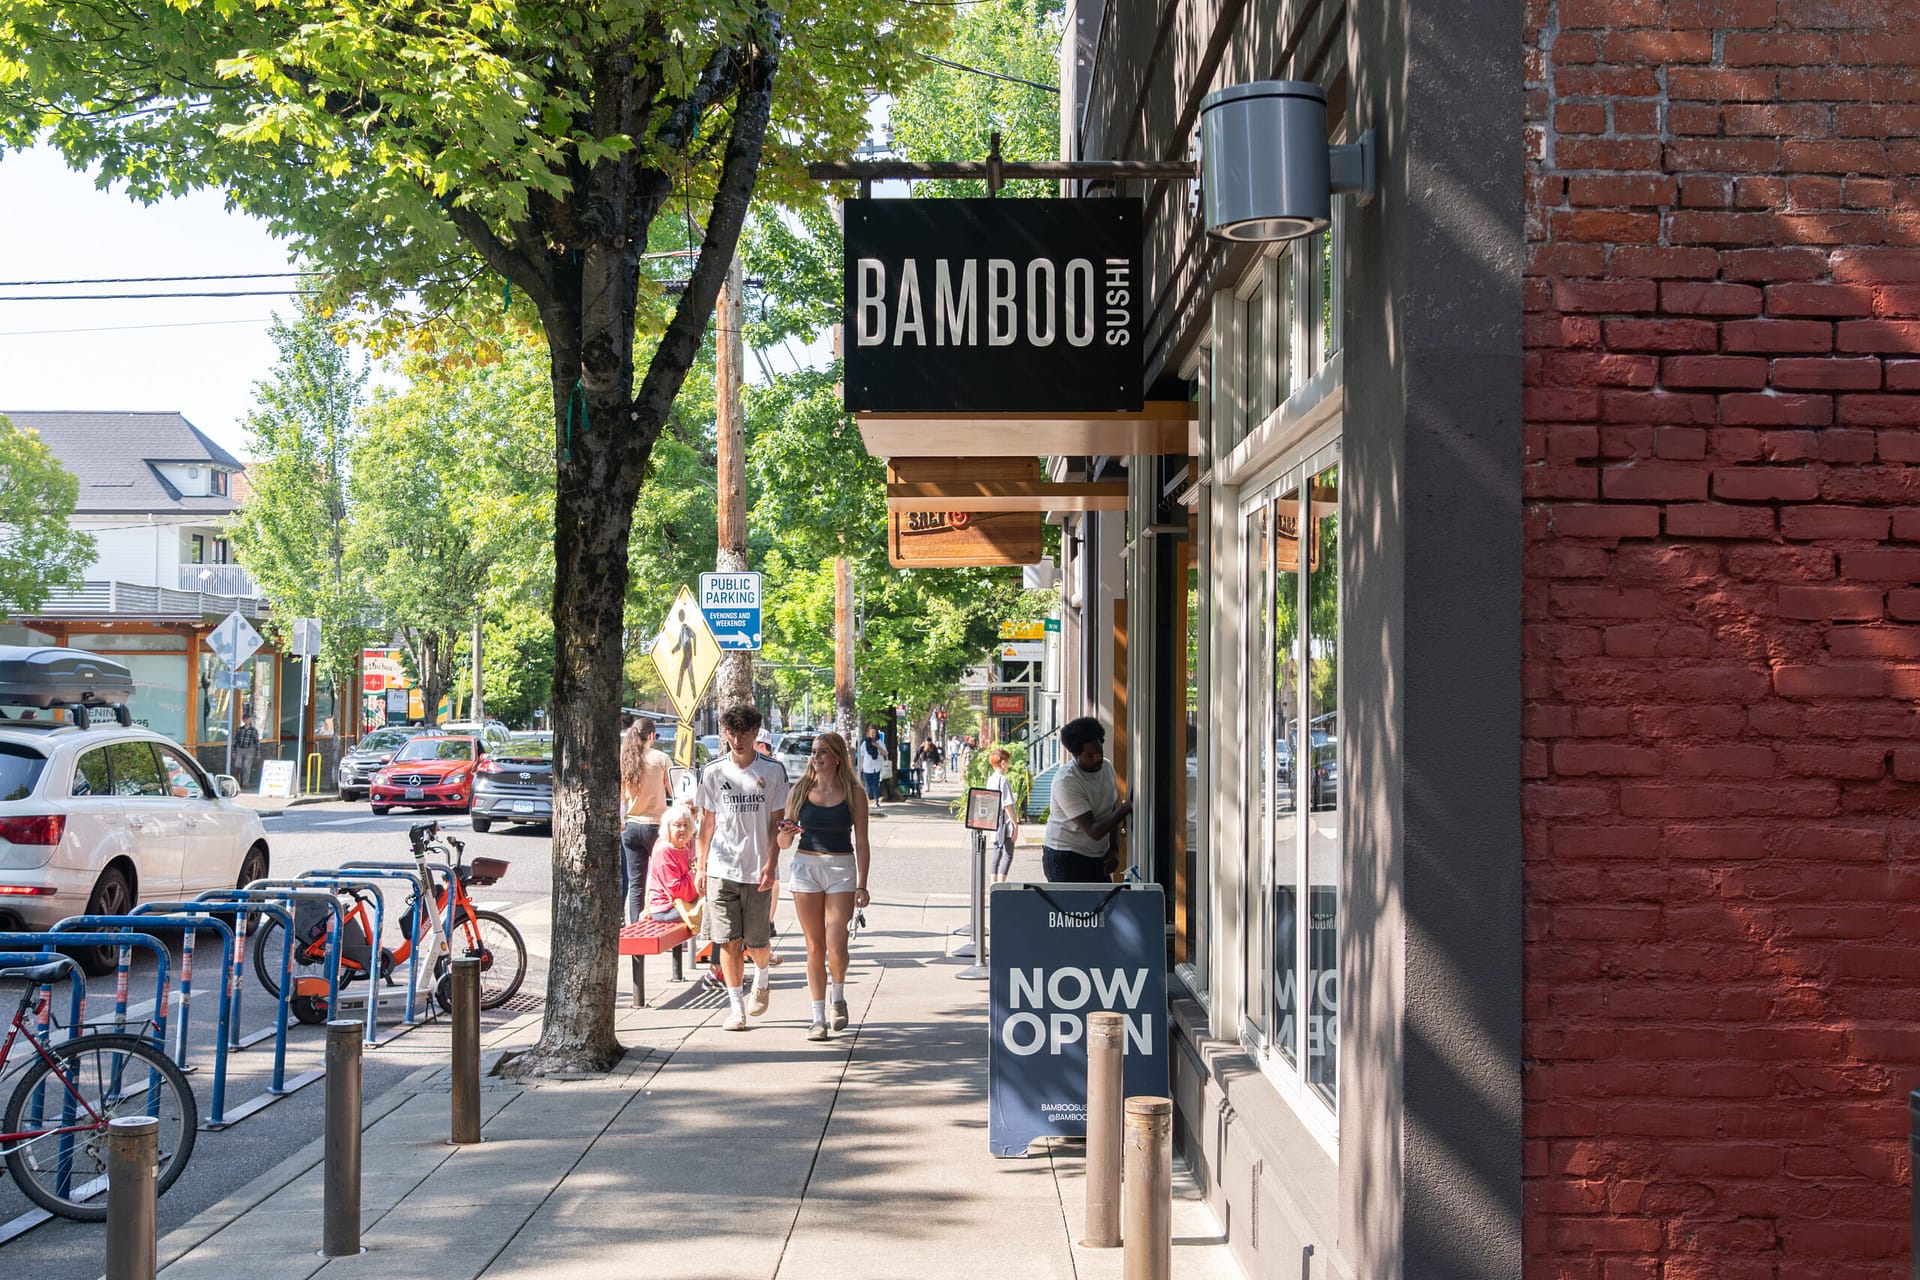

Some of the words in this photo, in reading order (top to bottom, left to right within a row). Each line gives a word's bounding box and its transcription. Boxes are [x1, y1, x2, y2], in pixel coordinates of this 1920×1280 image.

[857, 257, 1095, 348] BAMBOO
[1105, 257, 1131, 347] SUSHI
[711, 578, 751, 591] PUBLIC
[706, 591, 755, 604] PARKING
[709, 612, 737, 620] EVENINGS
[738, 612, 751, 620] AND
[723, 792, 766, 804] Emirates
[729, 803, 739, 813] FLY
[740, 803, 760, 812] BETTER
[1049, 911, 1098, 928] BAMBOO
[1009, 966, 1149, 1010] NOW
[1002, 1012, 1152, 1056] OPN
[1041, 1103, 1088, 1111] BAMBOOSUS
[1048, 1113, 1088, 1122] @BAMBOO
